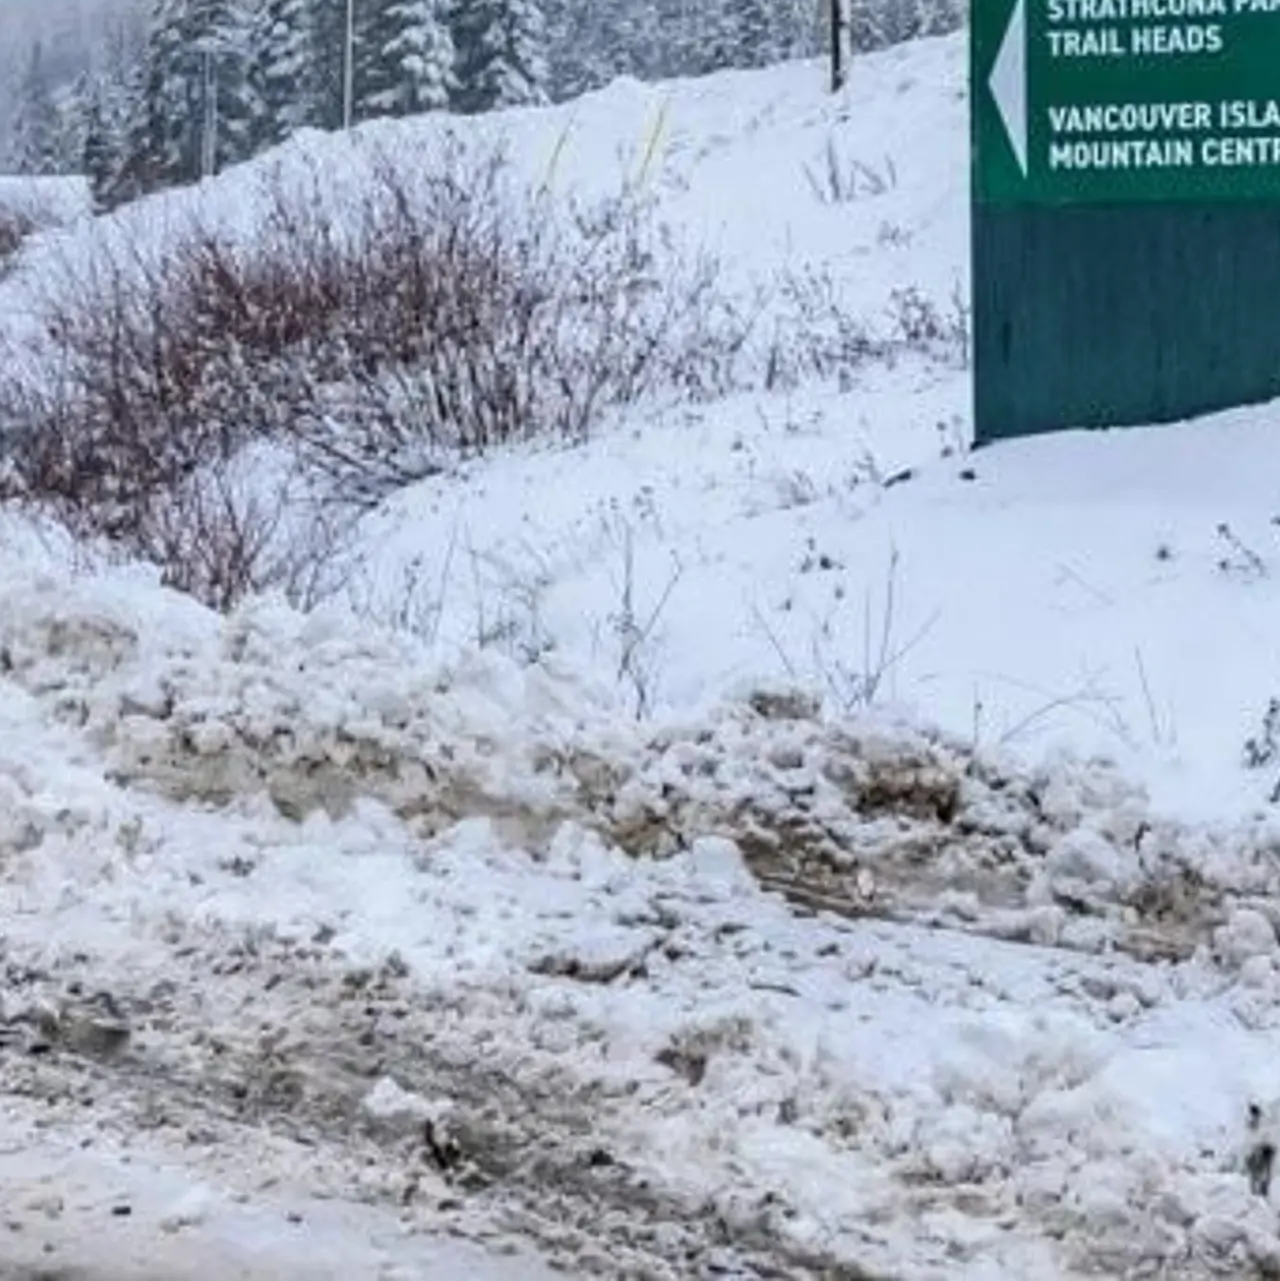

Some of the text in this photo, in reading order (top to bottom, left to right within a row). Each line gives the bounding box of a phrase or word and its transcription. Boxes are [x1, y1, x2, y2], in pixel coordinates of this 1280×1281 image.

[1047, 24, 1222, 57] TRAIL HEADS
[1048, 102, 1212, 133] VANCOUVER
[1048, 138, 1193, 171] MOUNTAIN
